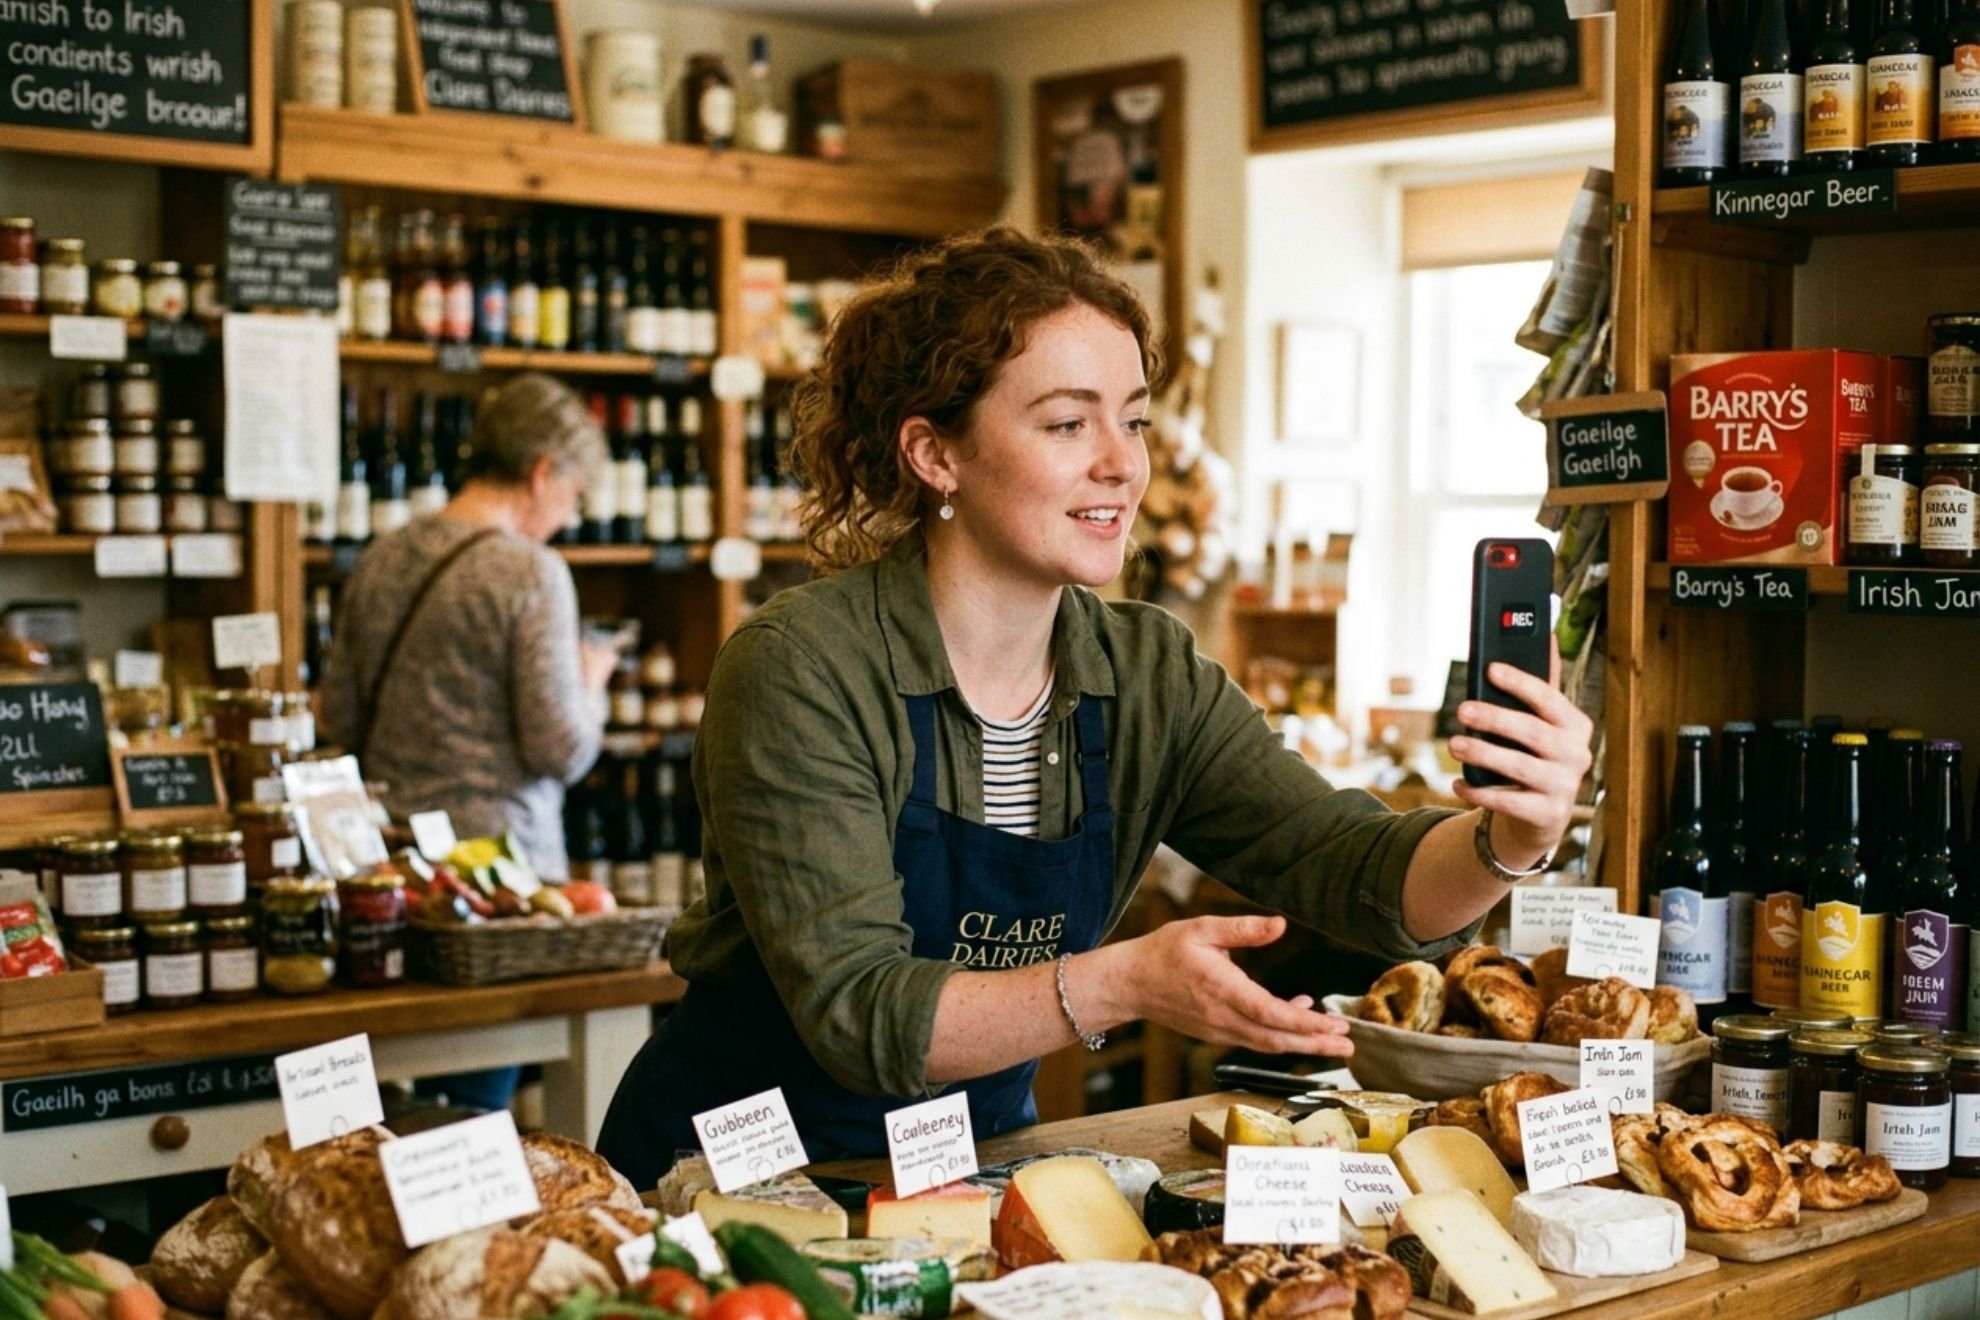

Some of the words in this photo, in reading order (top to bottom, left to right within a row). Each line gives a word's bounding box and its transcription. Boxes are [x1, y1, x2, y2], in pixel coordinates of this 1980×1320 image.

[82, 0, 113, 31] to
[125, 2, 186, 40] Irish
[11, 74, 127, 129] Gaeilge
[1715, 189, 1815, 219] Kinnegar
[1826, 179, 1880, 208] Beer
[1690, 384, 1808, 427] BARRY'S
[1561, 420, 1637, 450] Gaeilge
[1714, 423, 1777, 451] TEA
[1564, 448, 1642, 479] Gaeilgh
[1675, 570, 1744, 608] Barry's
[1754, 572, 1792, 598] Tea
[1860, 576, 1922, 608] Irish
[1512, 612, 1534, 626] REC
[959, 911, 1066, 943] CLARE
[95, 1086, 120, 1117] ga
[704, 1106, 775, 1139] Gubbeen
